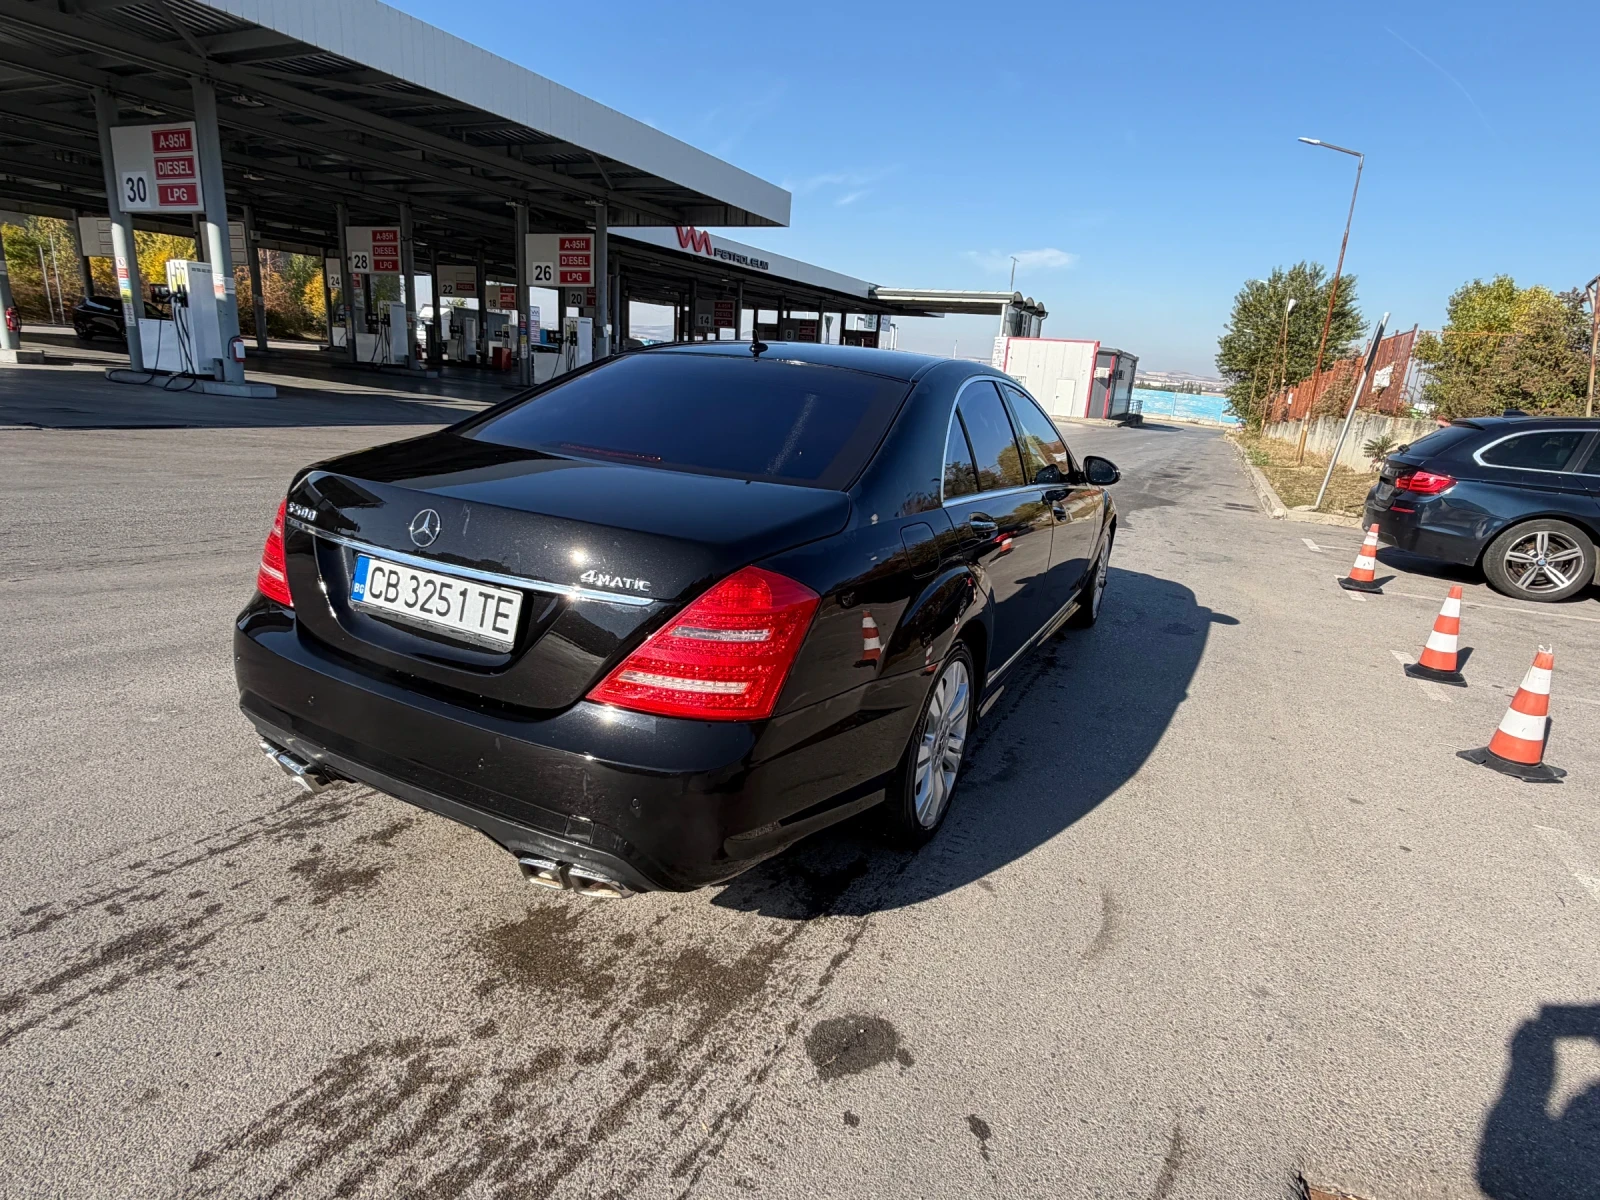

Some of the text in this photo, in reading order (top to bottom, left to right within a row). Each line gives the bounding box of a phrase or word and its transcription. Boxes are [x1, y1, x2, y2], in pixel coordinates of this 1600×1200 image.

[159, 134, 186, 148] A-95H
[158, 161, 192, 175] DIESEL
[126, 176, 147, 203] 30
[167, 188, 188, 201] LPG
[564, 240, 586, 249] A-95H
[374, 247, 396, 255] DIESEL
[354, 254, 368, 269] 28
[561, 256, 588, 265] DIESEL
[713, 247, 769, 270] PETROLEUM
[380, 261, 393, 269] LPG
[535, 265, 552, 281] 26
[567, 272, 583, 281] LPG
[331, 276, 340, 286] 24
[442, 284, 453, 294] 22
[489, 299, 497, 307] 18
[571, 293, 582, 304] 20
[700, 315, 710, 325] 14
[580, 570, 652, 592] 4MATIC
[353, 582, 365, 594] BG
[368, 566, 514, 635] CB 3251 TE
